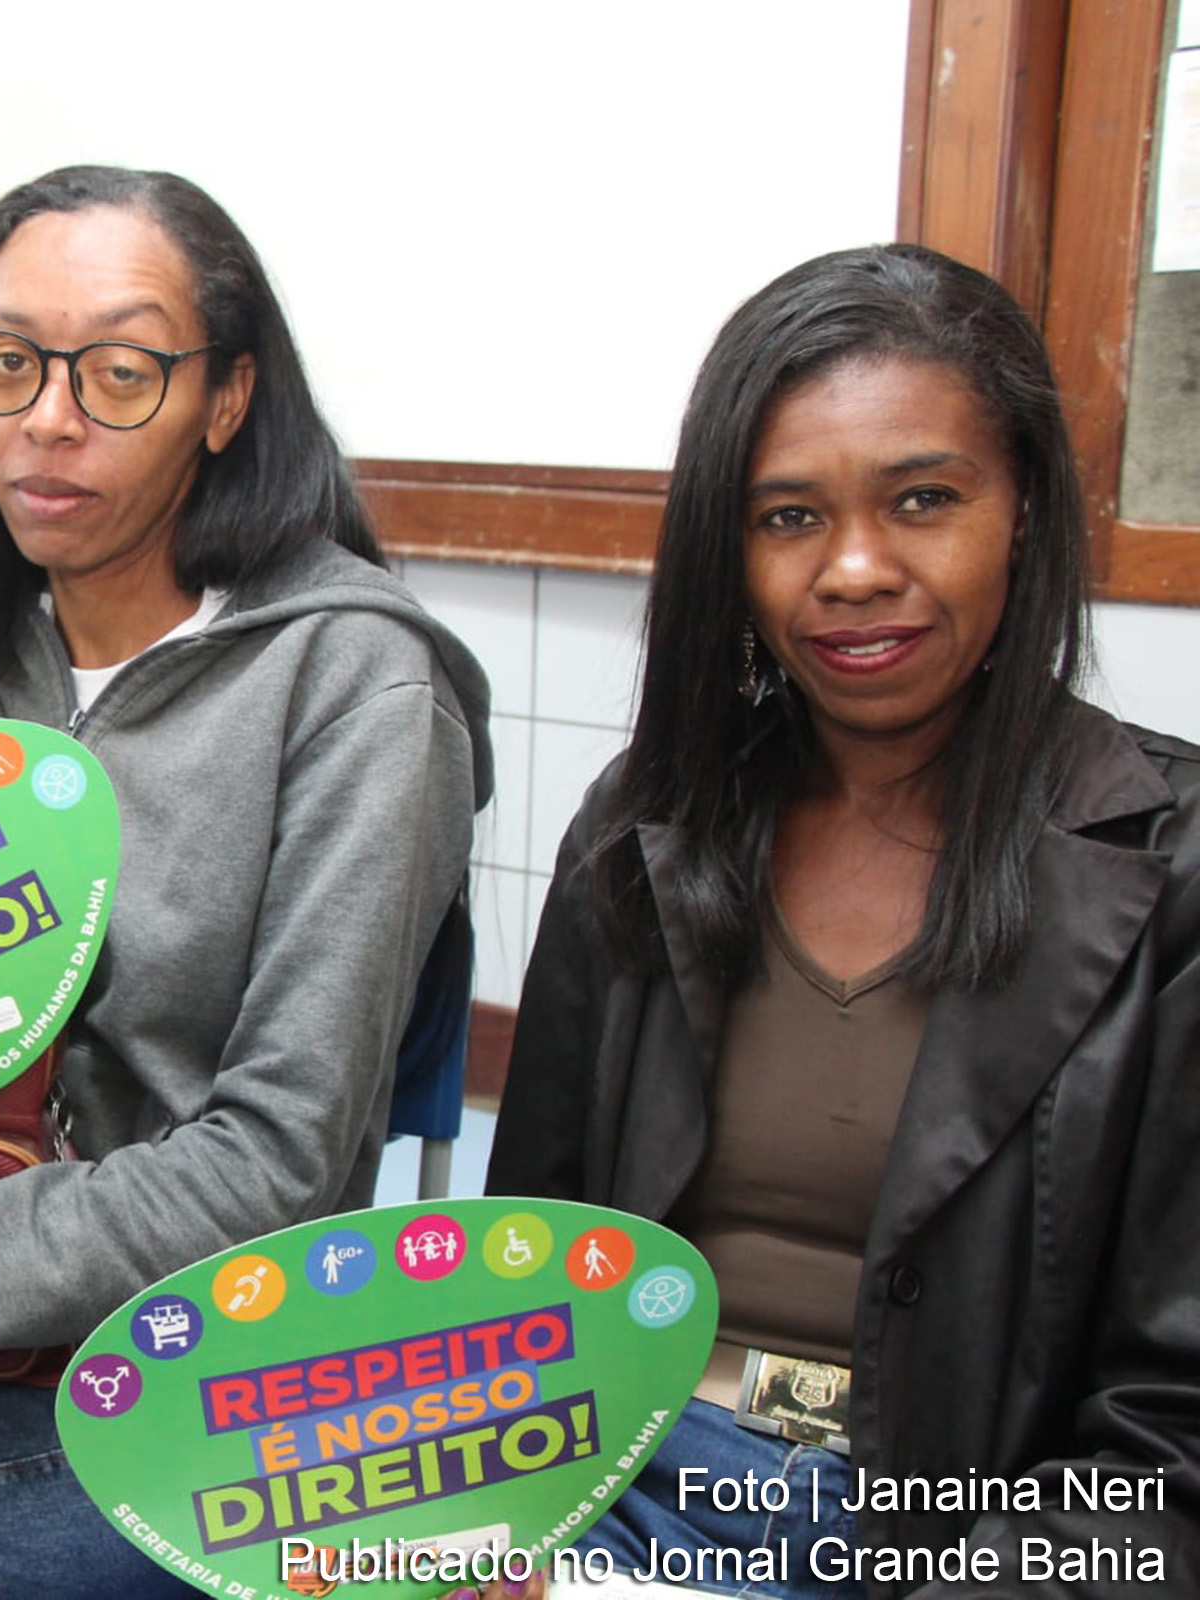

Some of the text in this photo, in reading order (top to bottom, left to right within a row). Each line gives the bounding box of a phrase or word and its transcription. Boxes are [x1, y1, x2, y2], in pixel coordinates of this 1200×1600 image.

[71, 941, 91, 967] DA
[80, 877, 108, 937] BAHIA
[18, 968, 79, 1050] HUMANOS
[337, 1247, 365, 1259] 60+
[208, 1313, 567, 1428] RESPEITO
[258, 1369, 535, 1474] É NOSSO
[200, 1403, 593, 1544] DIREITO!
[531, 1409, 670, 1557] MANOS DA BAHIA
[112, 1503, 257, 1600] SECRETARIA DE
